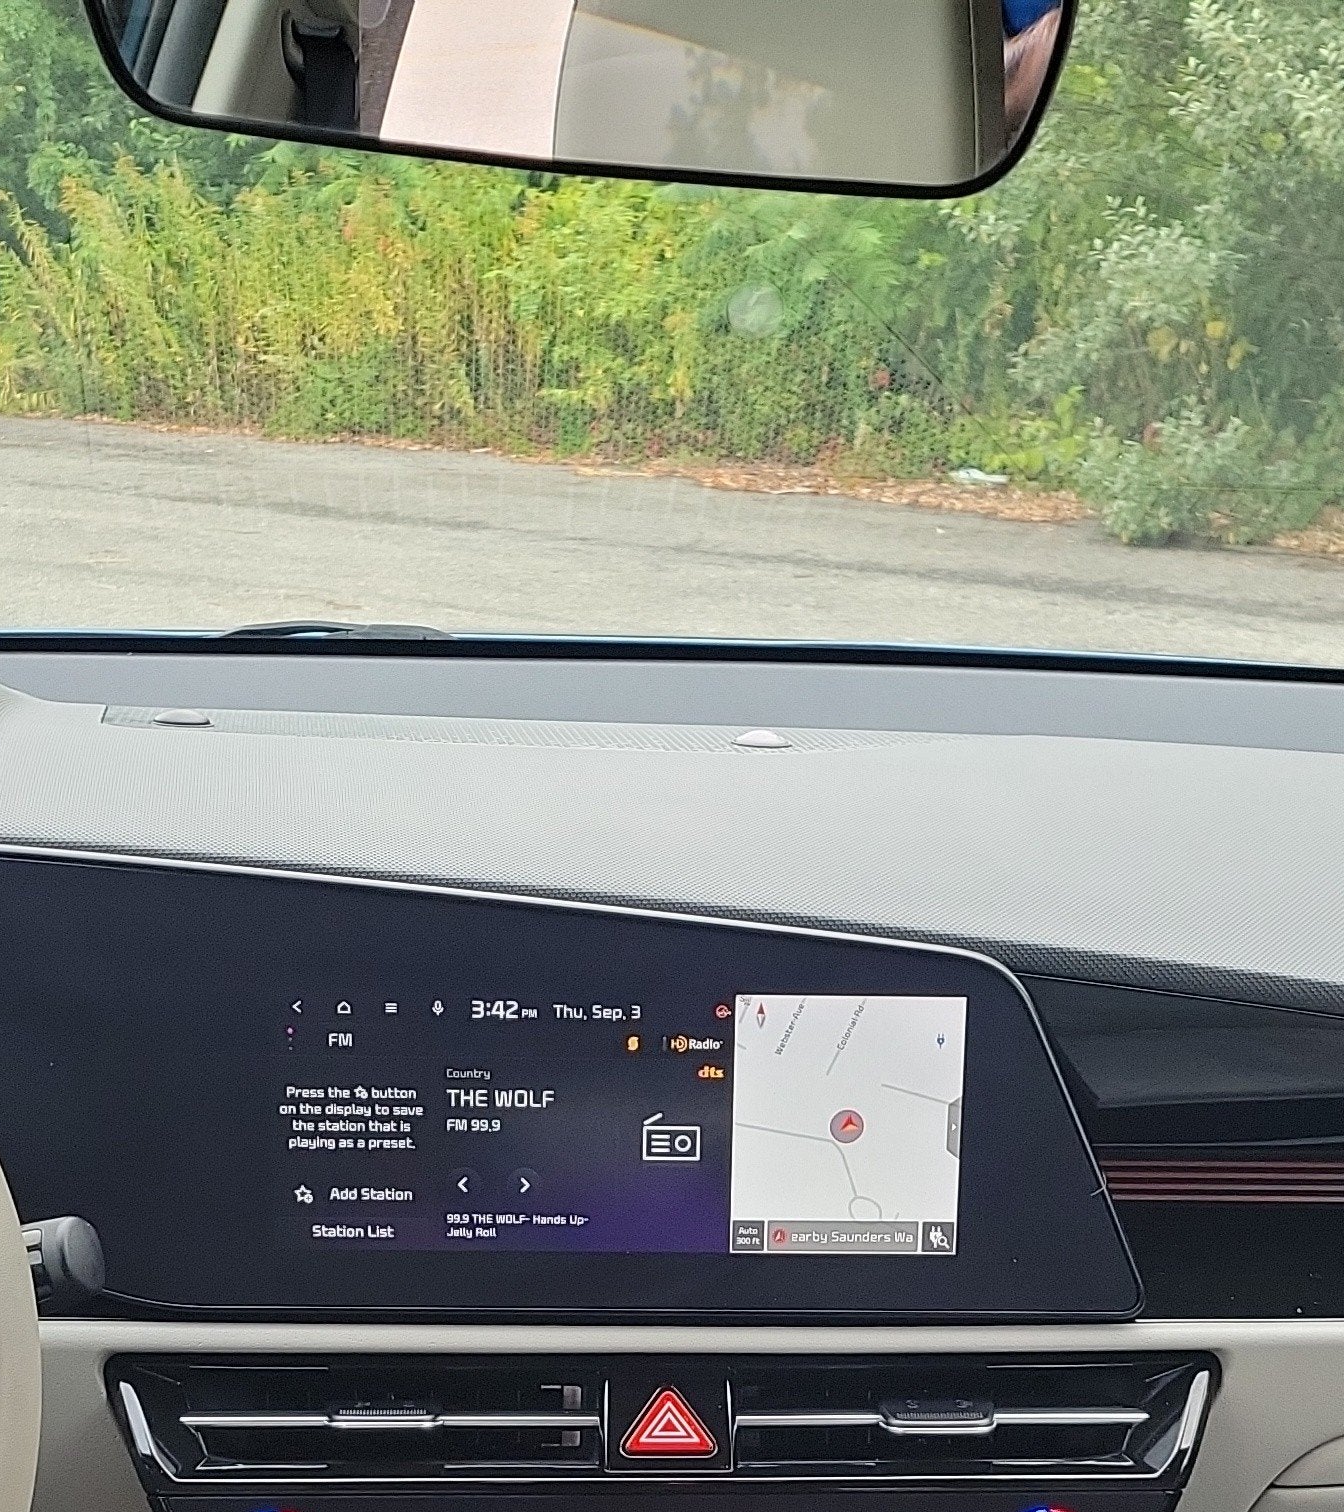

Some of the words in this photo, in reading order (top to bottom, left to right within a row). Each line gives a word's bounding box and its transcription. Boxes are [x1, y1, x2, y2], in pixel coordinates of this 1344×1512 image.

[471, 1000, 519, 1020] 3:42
[521, 1008, 538, 1019] PM
[631, 1005, 641, 1020] 3
[329, 1033, 353, 1047] FM
[688, 1038, 720, 1050] Radio
[446, 1068, 491, 1080] Country
[698, 1065, 725, 1078] dts
[286, 1087, 325, 1099] Press
[328, 1087, 351, 1099] the
[371, 1087, 417, 1099] button
[446, 1089, 488, 1108] THE
[494, 1089, 555, 1108] WOLF
[279, 1105, 295, 1116] on
[298, 1103, 322, 1115] the
[325, 1104, 372, 1118] display
[375, 1104, 389, 1116] to
[392, 1106, 424, 1116] save
[292, 1121, 315, 1132] the
[318, 1121, 365, 1132] station
[369, 1121, 397, 1132] that
[399, 1121, 411, 1132] is
[446, 1119, 468, 1132] FM
[471, 1119, 501, 1133] 99.9
[288, 1138, 336, 1151] playing
[338, 1140, 354, 1149] as
[357, 1140, 365, 1149] a
[368, 1138, 416, 1151] preset.
[329, 1188, 359, 1202] Add
[361, 1187, 413, 1201] Station
[471, 1214, 493, 1225] THE
[532, 1214, 566, 1226] Hands
[312, 1224, 364, 1238] Station
[366, 1224, 395, 1238] List
[446, 1227, 472, 1239] Jelly
[475, 1227, 497, 1238] Roll
[738, 1226, 758, 1235] Auto
[831, 1230, 891, 1243] Saunders
[894, 1230, 914, 1243] Wa
[736, 1236, 751, 1246] 300
[753, 1235, 761, 1246] ft
